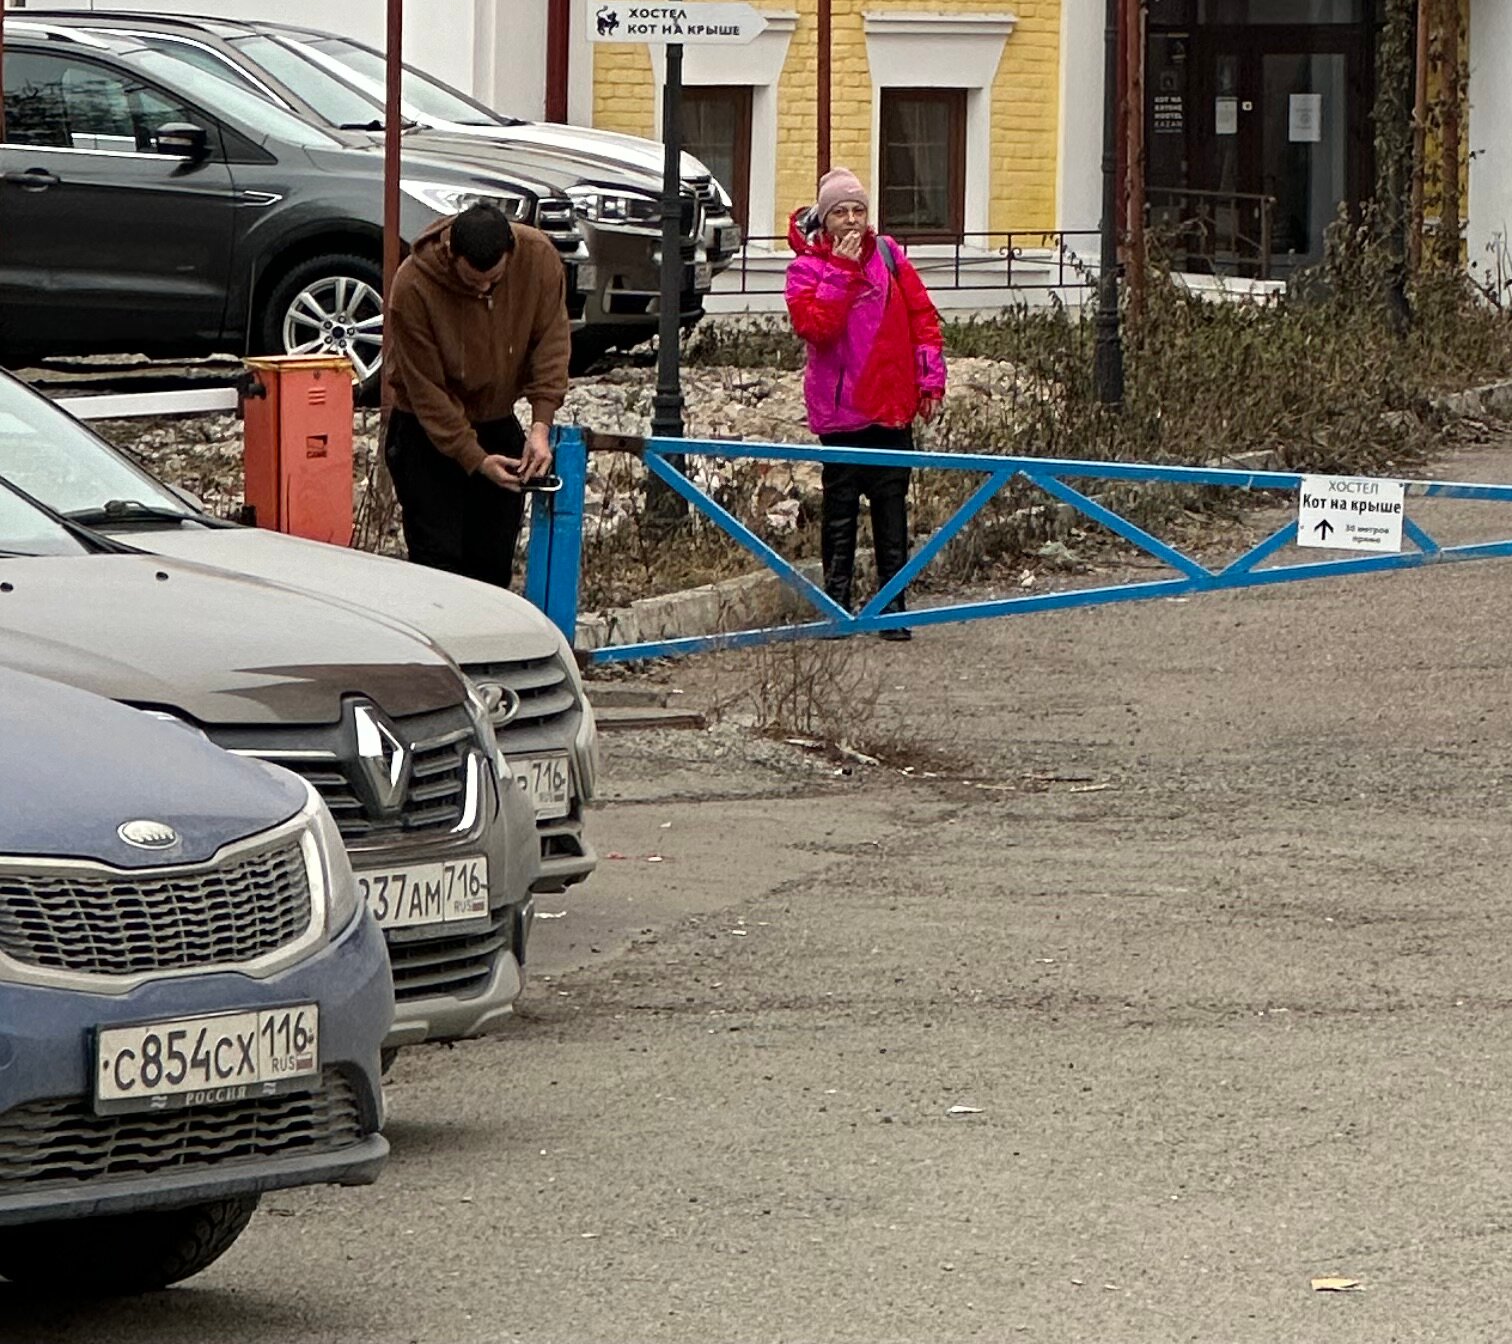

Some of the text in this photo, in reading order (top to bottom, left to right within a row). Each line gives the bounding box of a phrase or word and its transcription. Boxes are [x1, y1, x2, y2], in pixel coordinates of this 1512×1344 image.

[628, 8, 687, 19] ХОСТЕЛ
[627, 24, 740, 36] КОТ НА КРЫШЕ
[1328, 480, 1379, 494] ХОСТЕЛ
[1303, 493, 1402, 516] Кот на крыше
[533, 760, 563, 792] 716
[444, 862, 480, 901] 716
[114, 1011, 308, 1090] С854СХ 116
[271, 1055, 296, 1073] RUS
[185, 1086, 248, 1105] РОССИЯ
